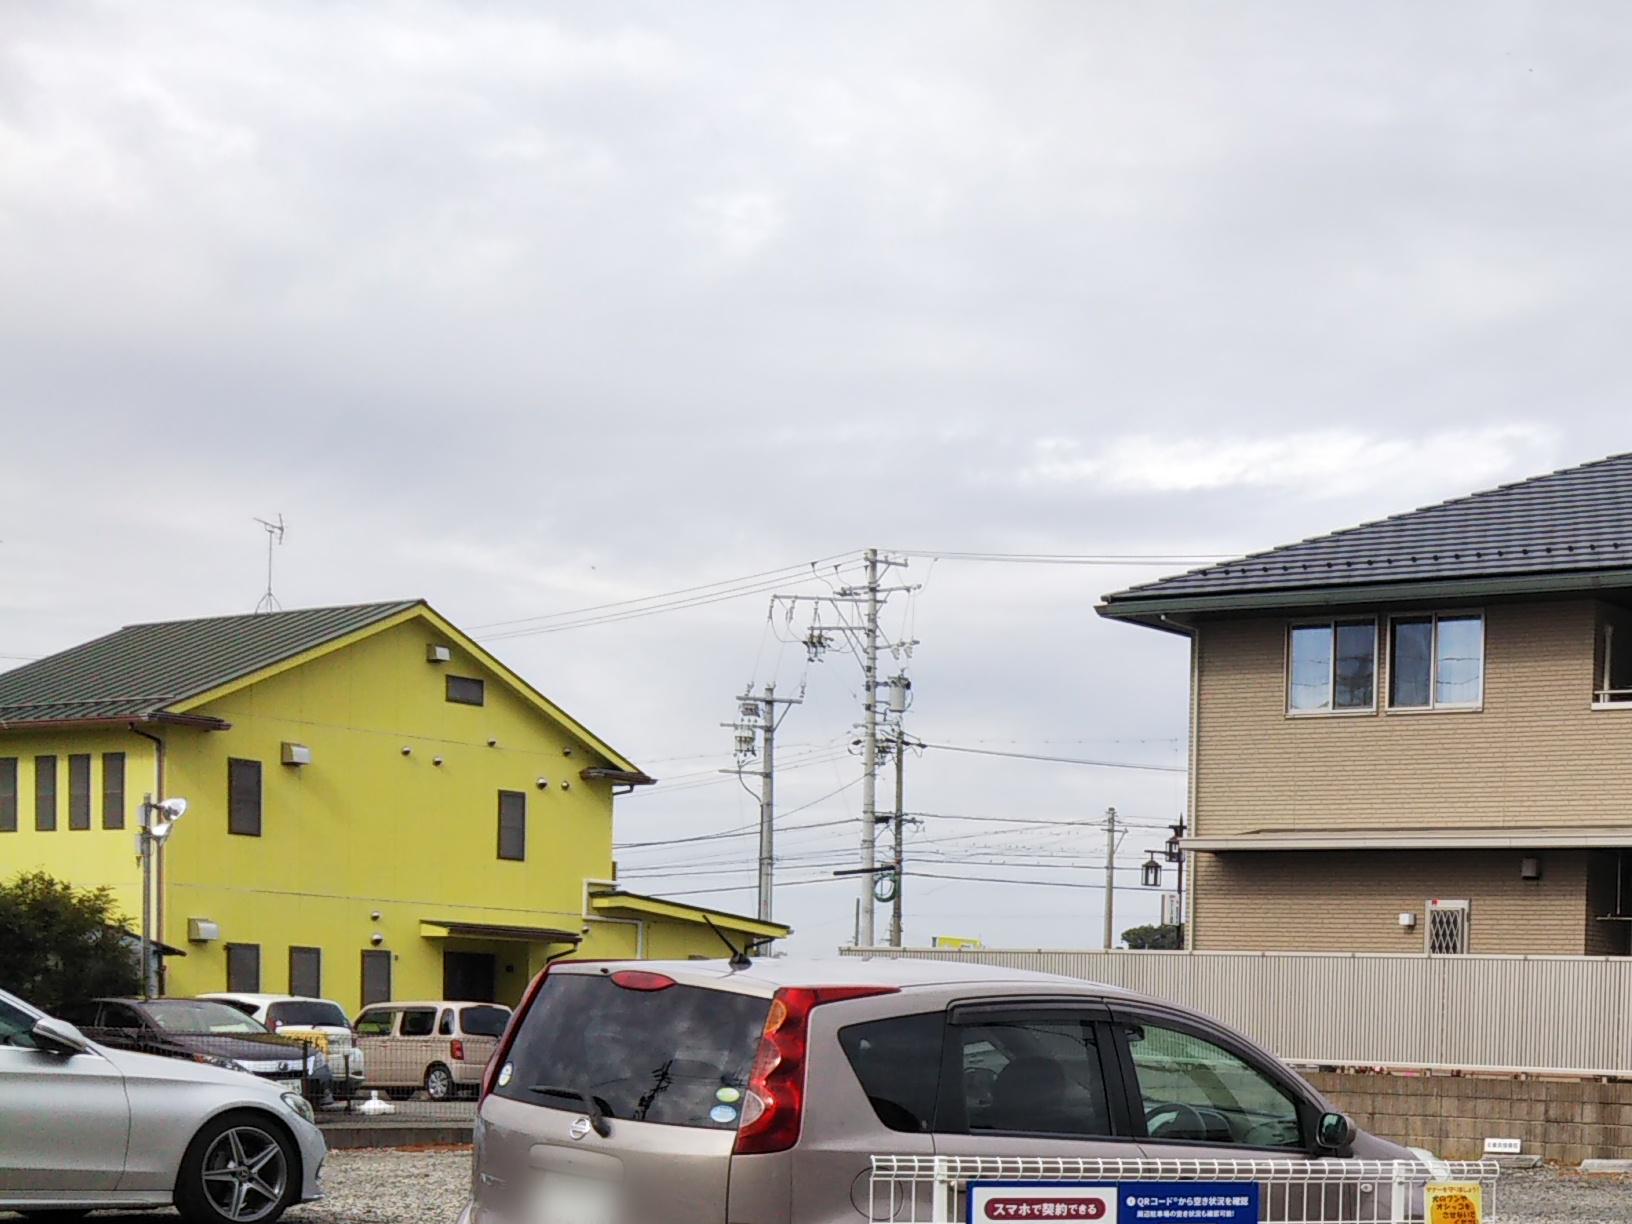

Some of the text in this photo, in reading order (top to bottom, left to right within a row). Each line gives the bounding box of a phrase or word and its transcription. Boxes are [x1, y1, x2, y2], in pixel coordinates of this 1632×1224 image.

[993, 1203, 1097, 1216] スマホで契約できる
